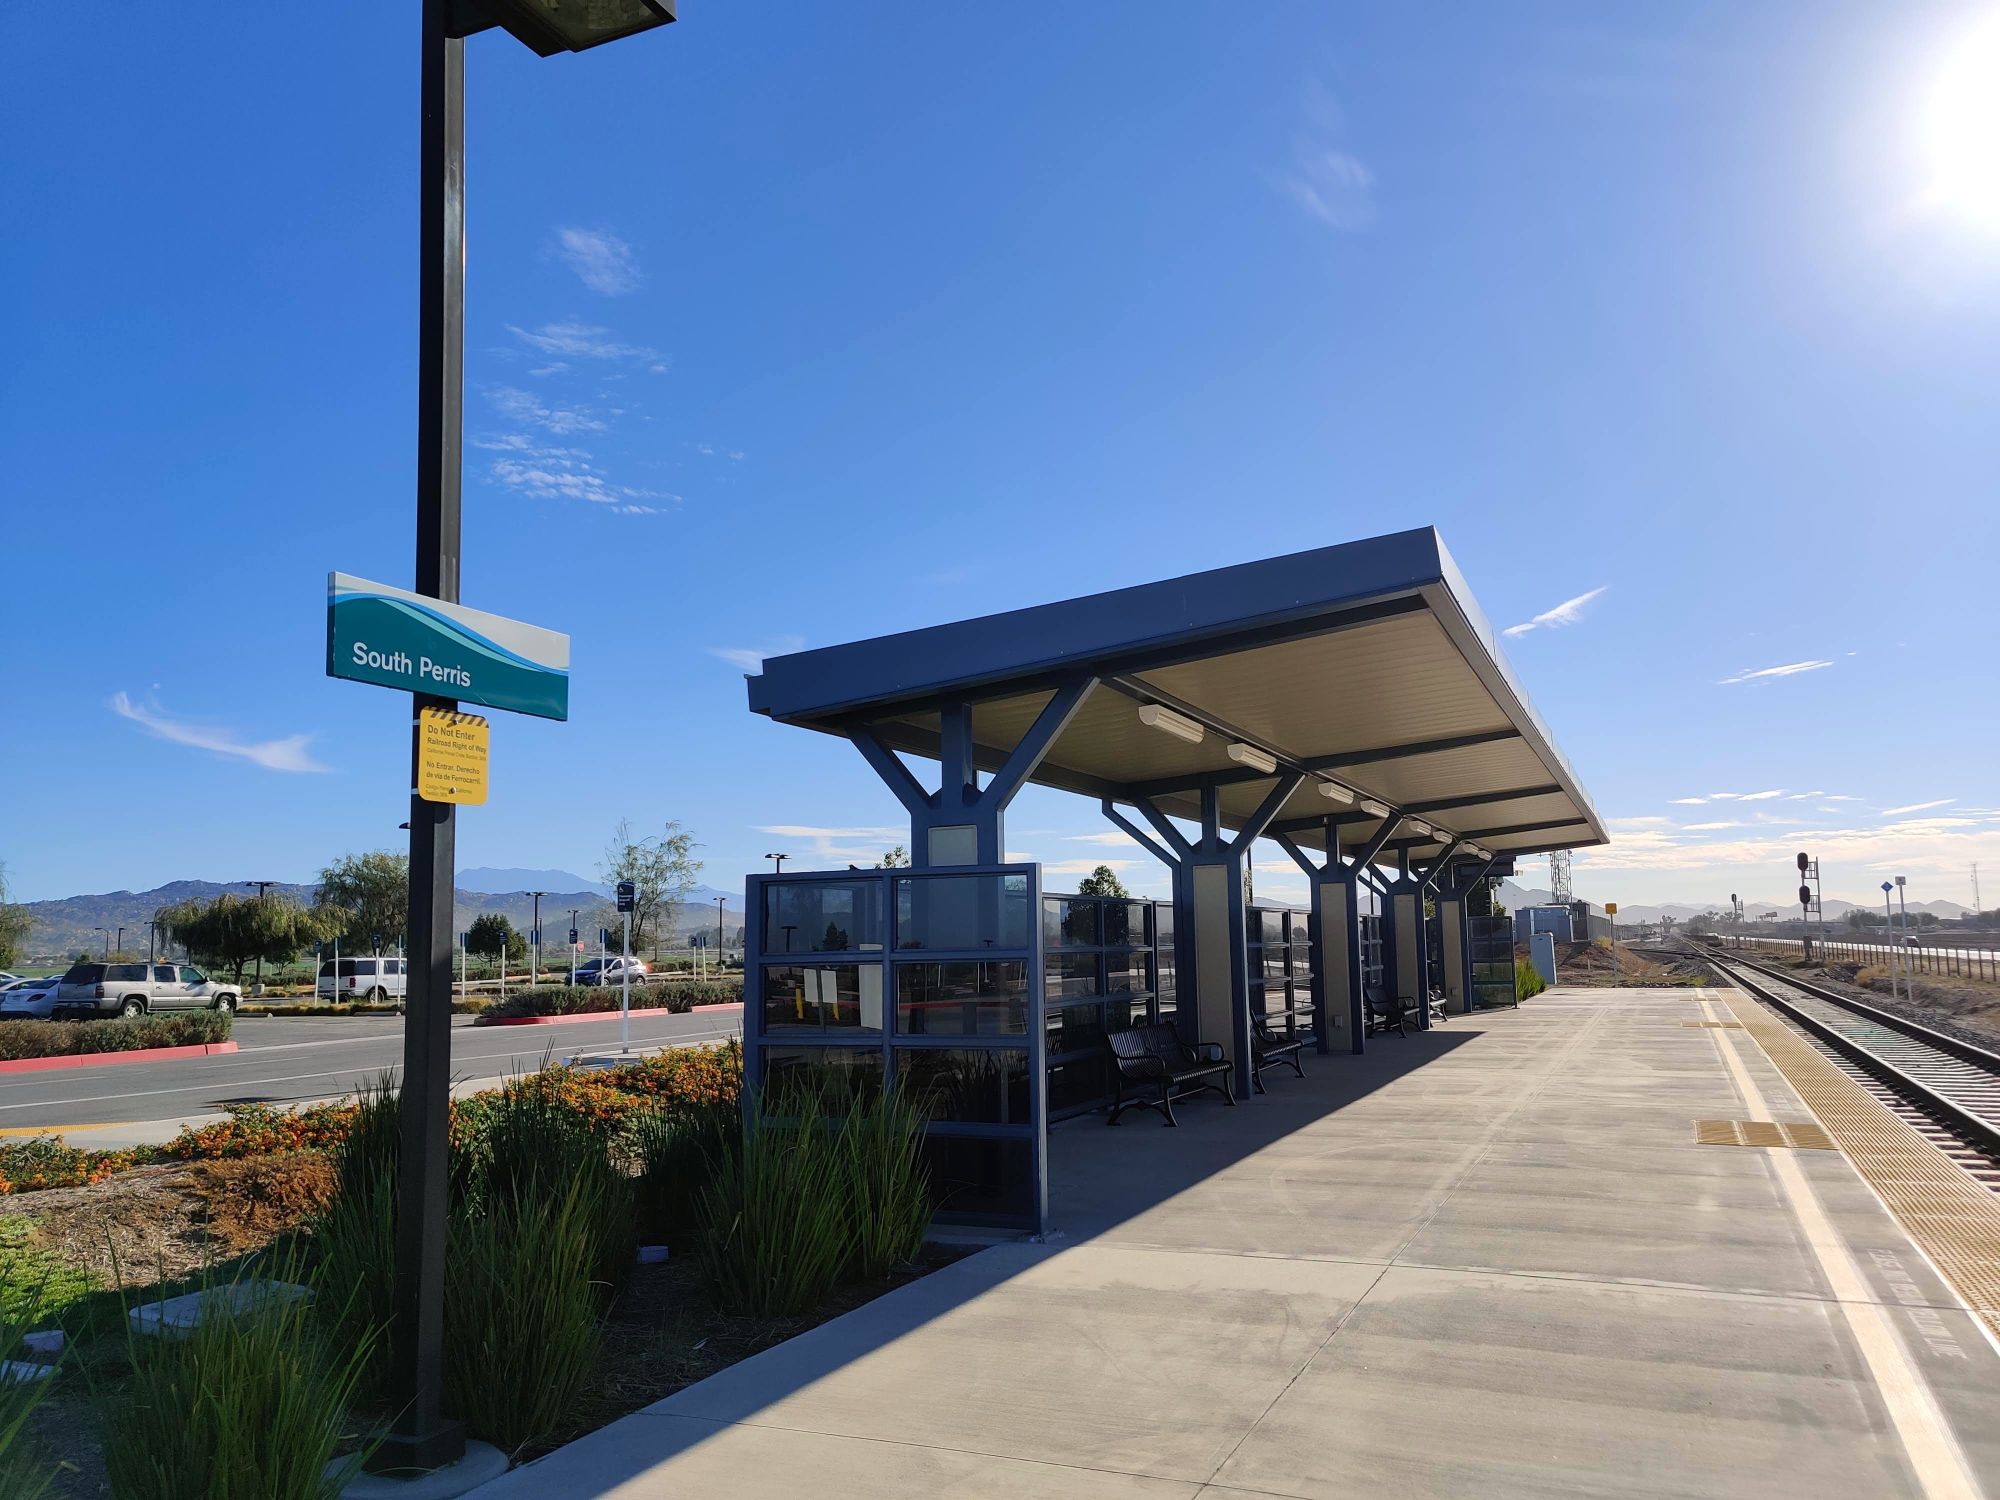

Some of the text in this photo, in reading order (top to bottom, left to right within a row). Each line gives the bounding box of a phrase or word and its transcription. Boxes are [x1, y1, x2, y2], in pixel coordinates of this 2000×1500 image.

[352, 641, 471, 687] South Perris
[427, 724, 475, 741] Do Not Enter
[427, 737, 451, 747] Railroad
[452, 741, 467, 751] Right
[475, 745, 487, 754] Way
[426, 760, 435, 768] No
[456, 765, 480, 774] Derecho
